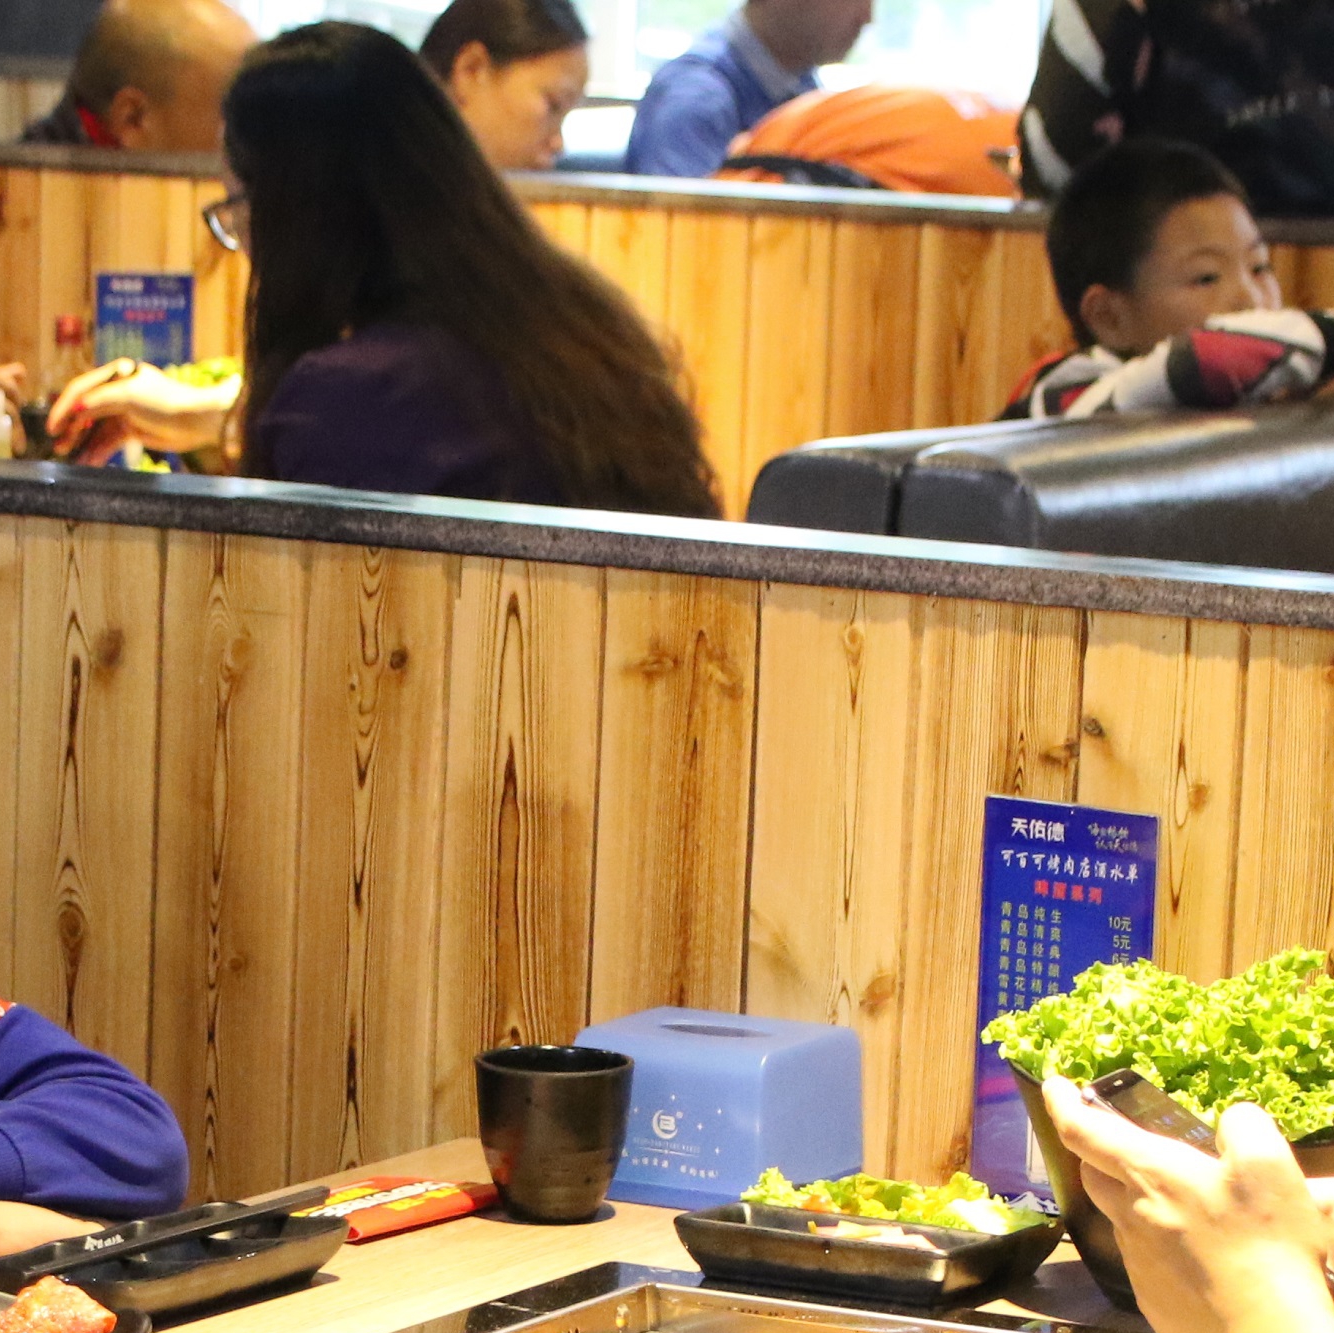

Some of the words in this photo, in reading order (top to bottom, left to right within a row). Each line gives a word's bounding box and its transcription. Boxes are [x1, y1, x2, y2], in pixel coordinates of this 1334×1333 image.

[1011, 817, 1065, 842] 天佑德
[1001, 850, 1138, 884] 可百可烤肉店酒水单
[1109, 917, 1132, 932] 10元
[1113, 935, 1131, 950] 5元
